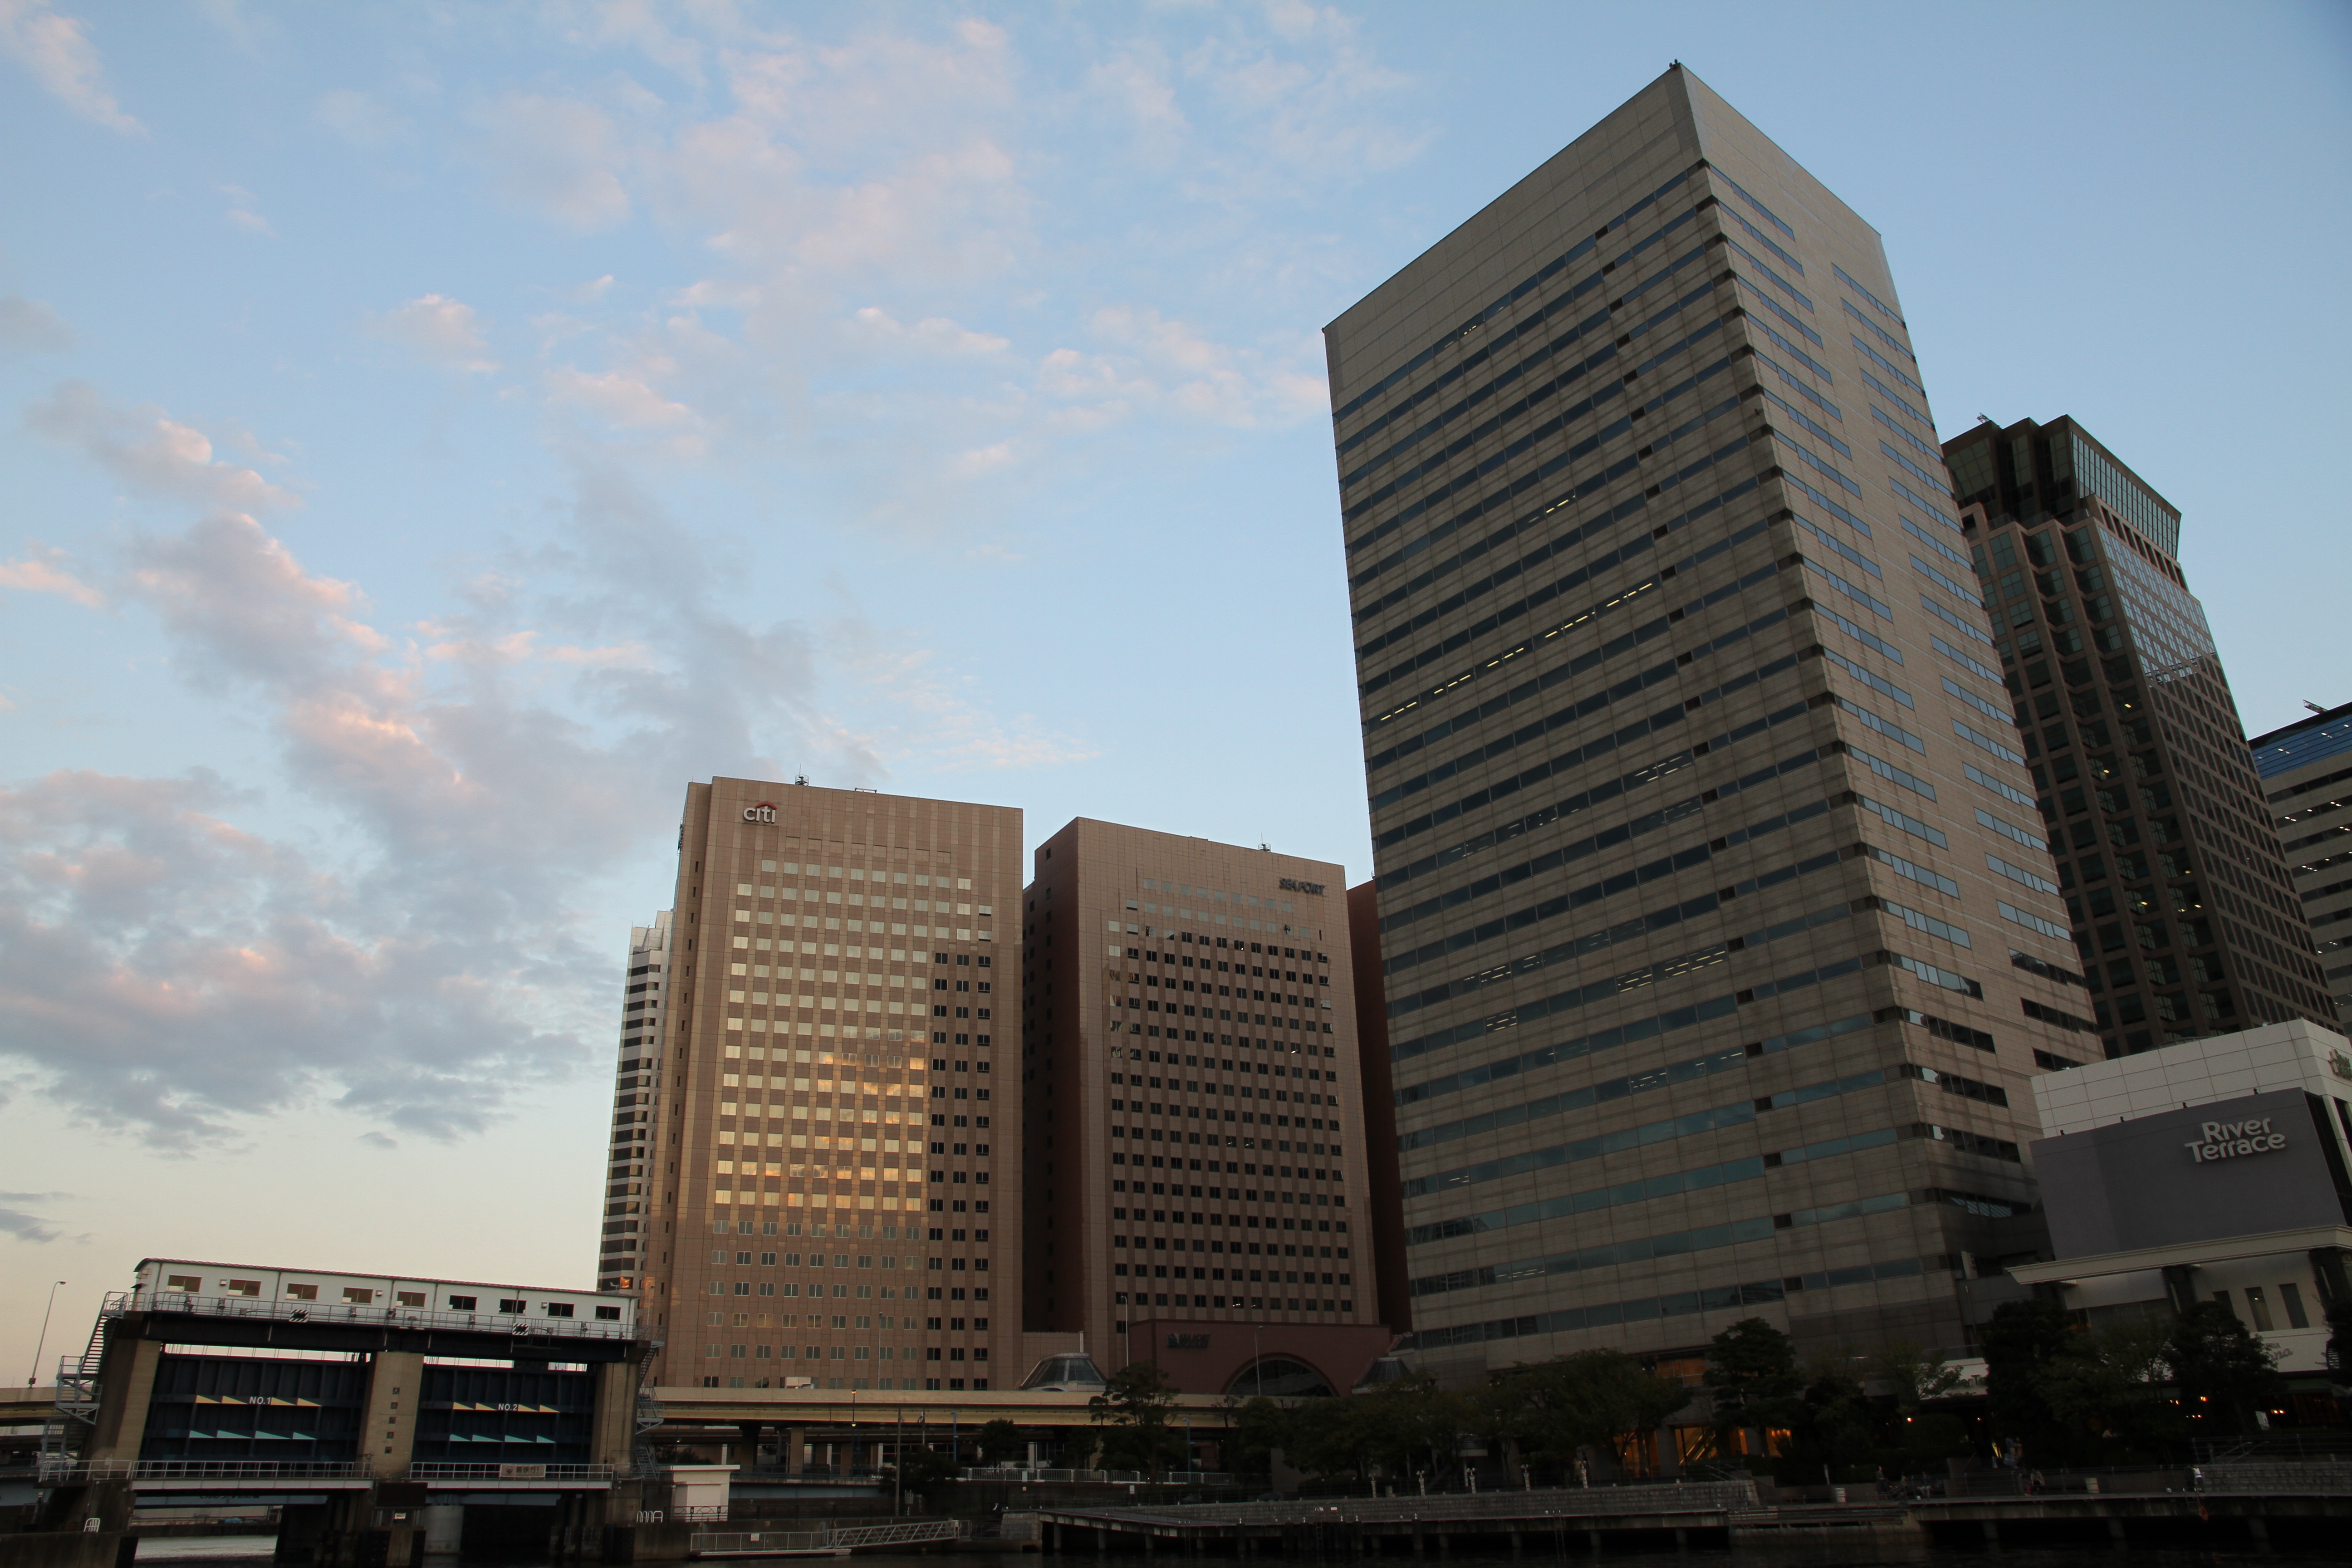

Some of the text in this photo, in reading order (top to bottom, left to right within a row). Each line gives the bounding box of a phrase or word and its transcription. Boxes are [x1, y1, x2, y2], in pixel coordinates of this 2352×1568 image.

[743, 805, 776, 823] citi
[2201, 1117, 2270, 1142] River
[2185, 1134, 2286, 1162] Terrace
[249, 1396, 271, 1404] NO.1
